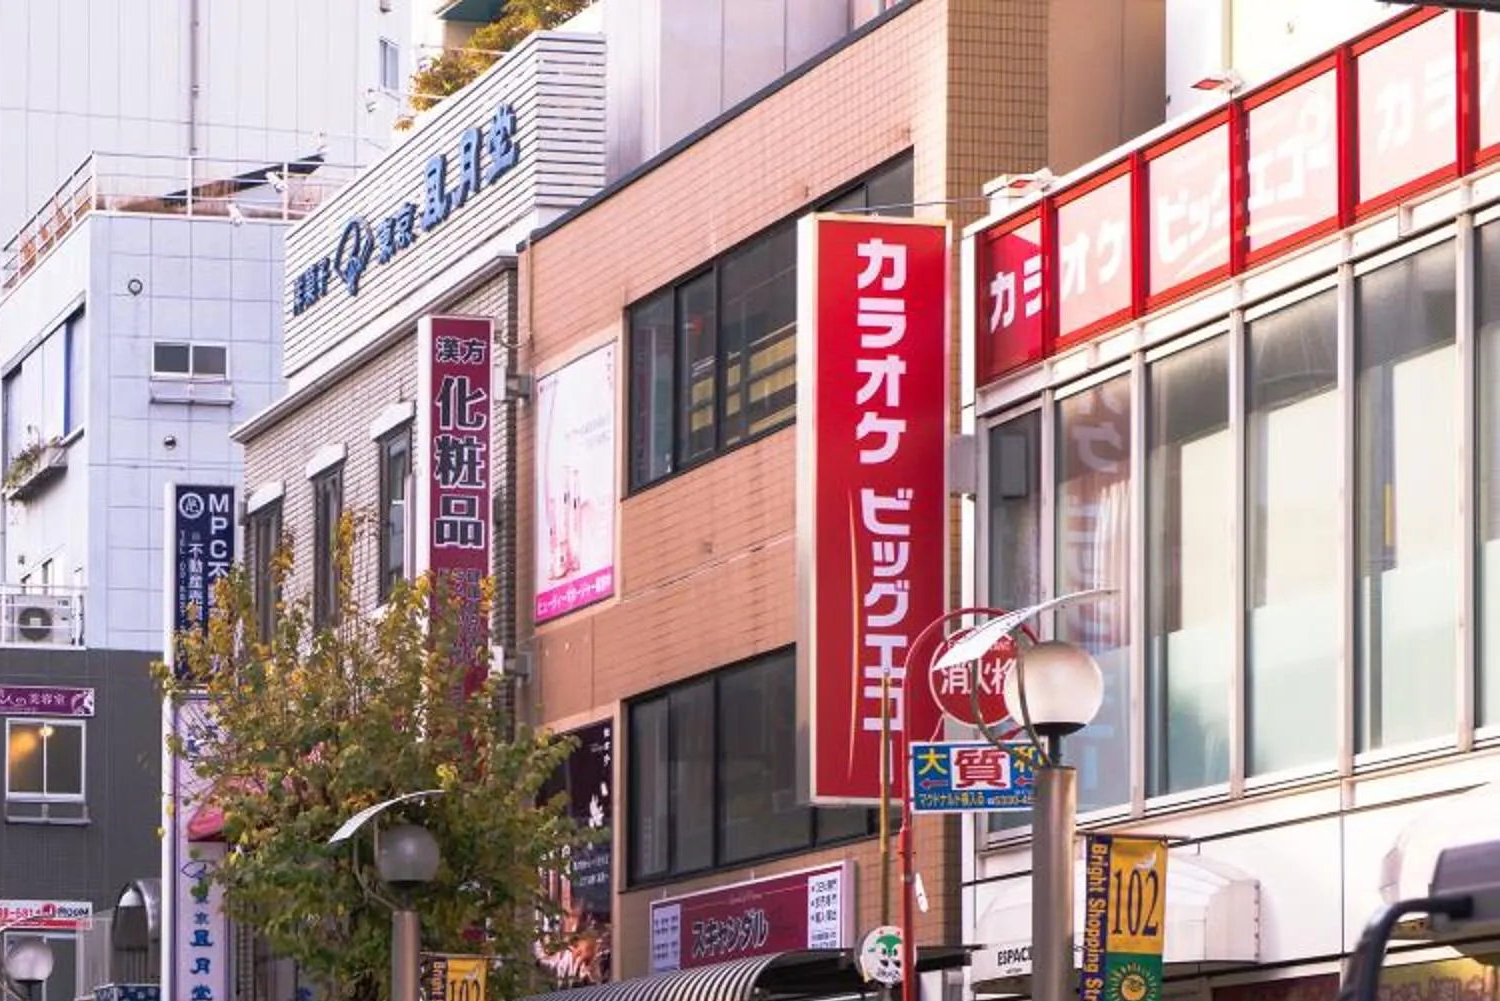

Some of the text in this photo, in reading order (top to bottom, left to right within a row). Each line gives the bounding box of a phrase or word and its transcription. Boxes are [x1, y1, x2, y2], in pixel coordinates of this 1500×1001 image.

[436, 336, 485, 364] 漢方
[856, 237, 907, 466] カラオケ
[435, 376, 487, 549] 化粧品
[917, 748, 948, 775] 大
[955, 751, 1007, 788] 質
[1088, 843, 1109, 892] Bright
[1111, 868, 1159, 936] 102
[997, 946, 1032, 965] ESPAC
[1083, 899, 1107, 973] Shopping
